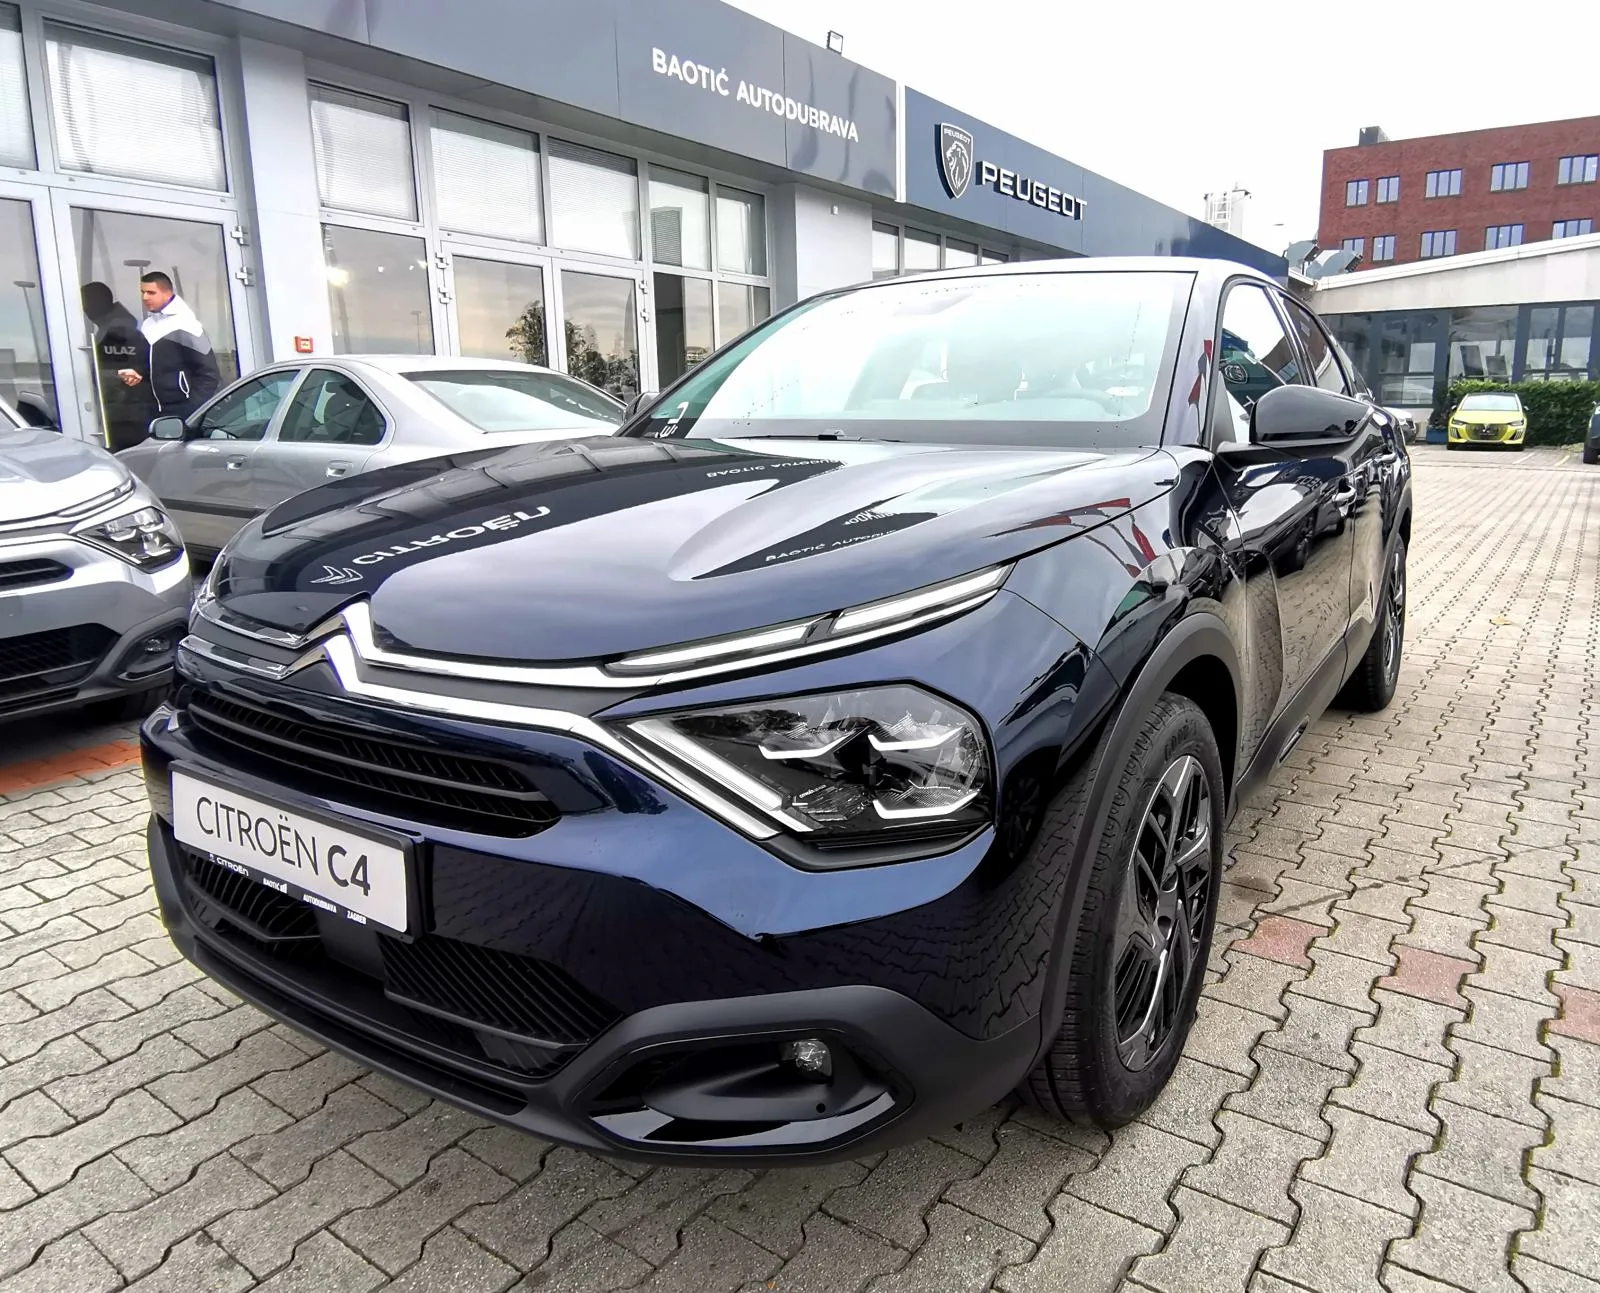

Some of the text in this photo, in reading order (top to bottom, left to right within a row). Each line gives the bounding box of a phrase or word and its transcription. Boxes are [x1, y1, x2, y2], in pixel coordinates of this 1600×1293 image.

[652, 47, 859, 143] BAOTIĆ AUTODUBRAVA
[943, 128, 971, 144] PEUGEOT
[981, 160, 1088, 221] PEUGEOT
[104, 345, 137, 356] ULAZ
[196, 796, 371, 897] CITROËN C4
